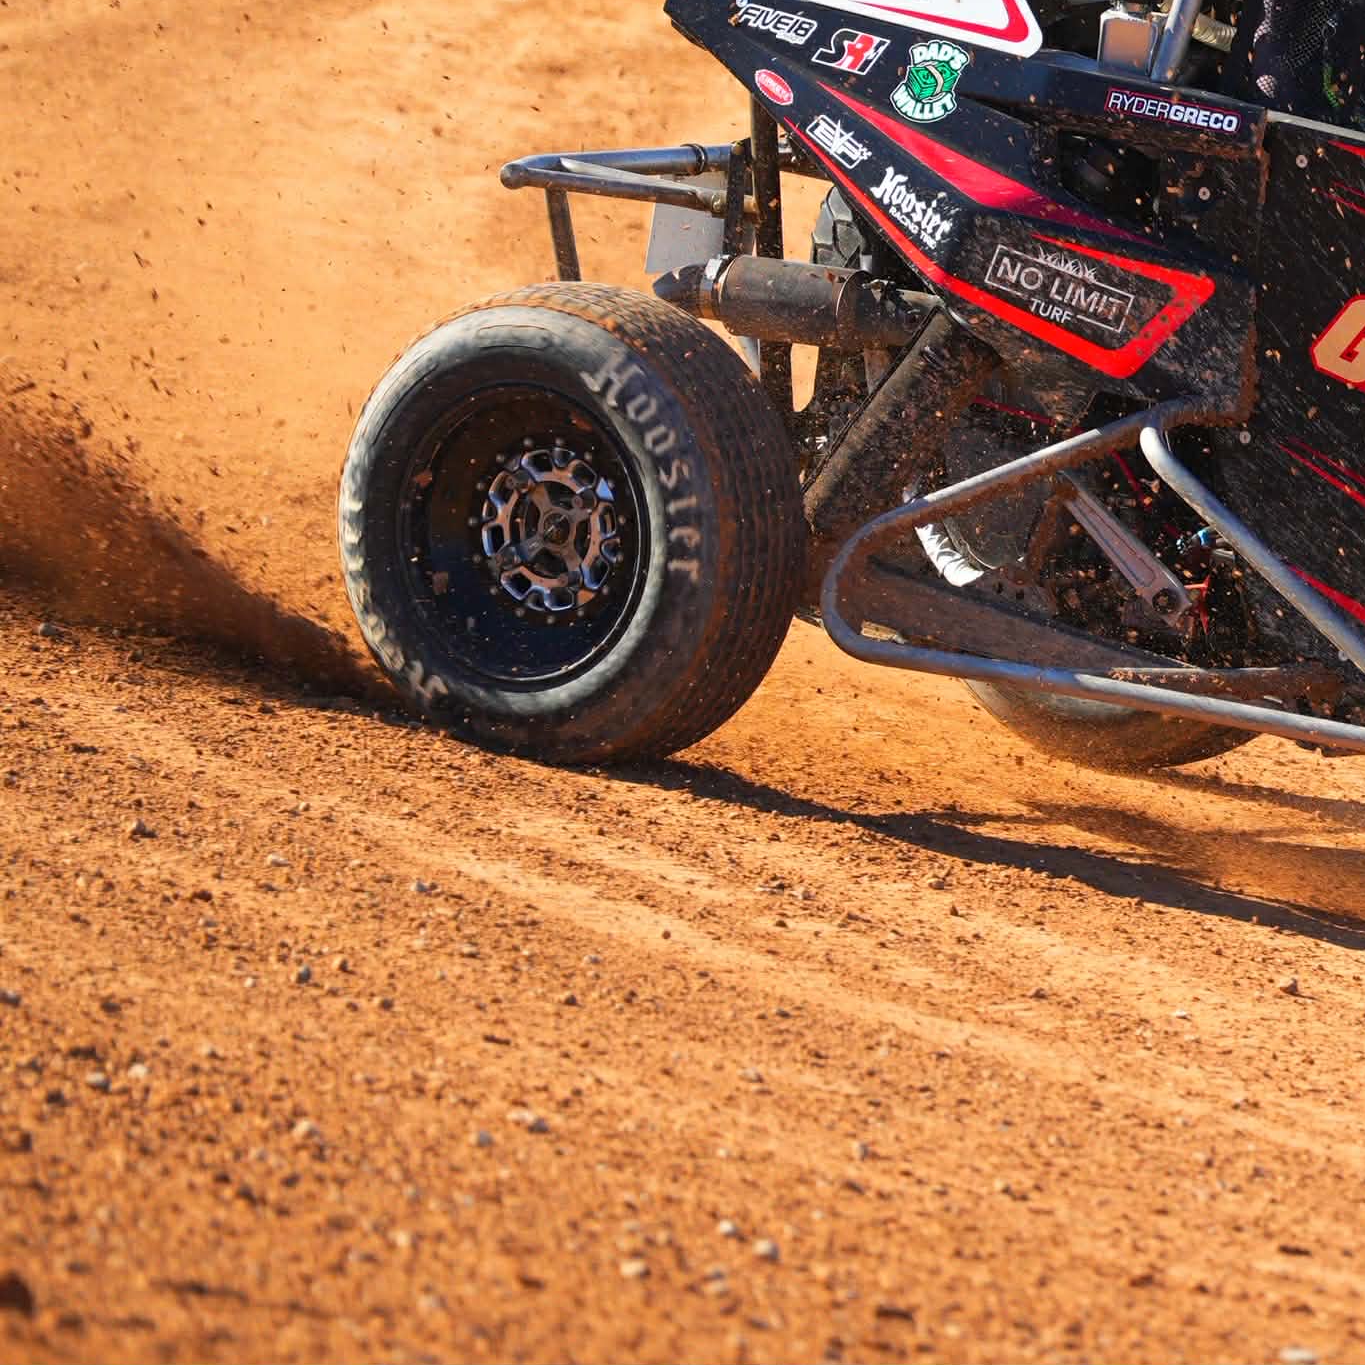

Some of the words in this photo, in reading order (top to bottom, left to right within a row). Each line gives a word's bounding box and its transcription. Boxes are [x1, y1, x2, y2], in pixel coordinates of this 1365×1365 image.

[911, 42, 968, 71] DAD'S
[893, 85, 956, 120] WALLET
[870, 166, 953, 241] Hoosier
[996, 256, 1044, 290] NO
[1049, 276, 1127, 321] LIMIT
[1030, 297, 1075, 325] TURF
[579, 347, 702, 583] Hoosier
